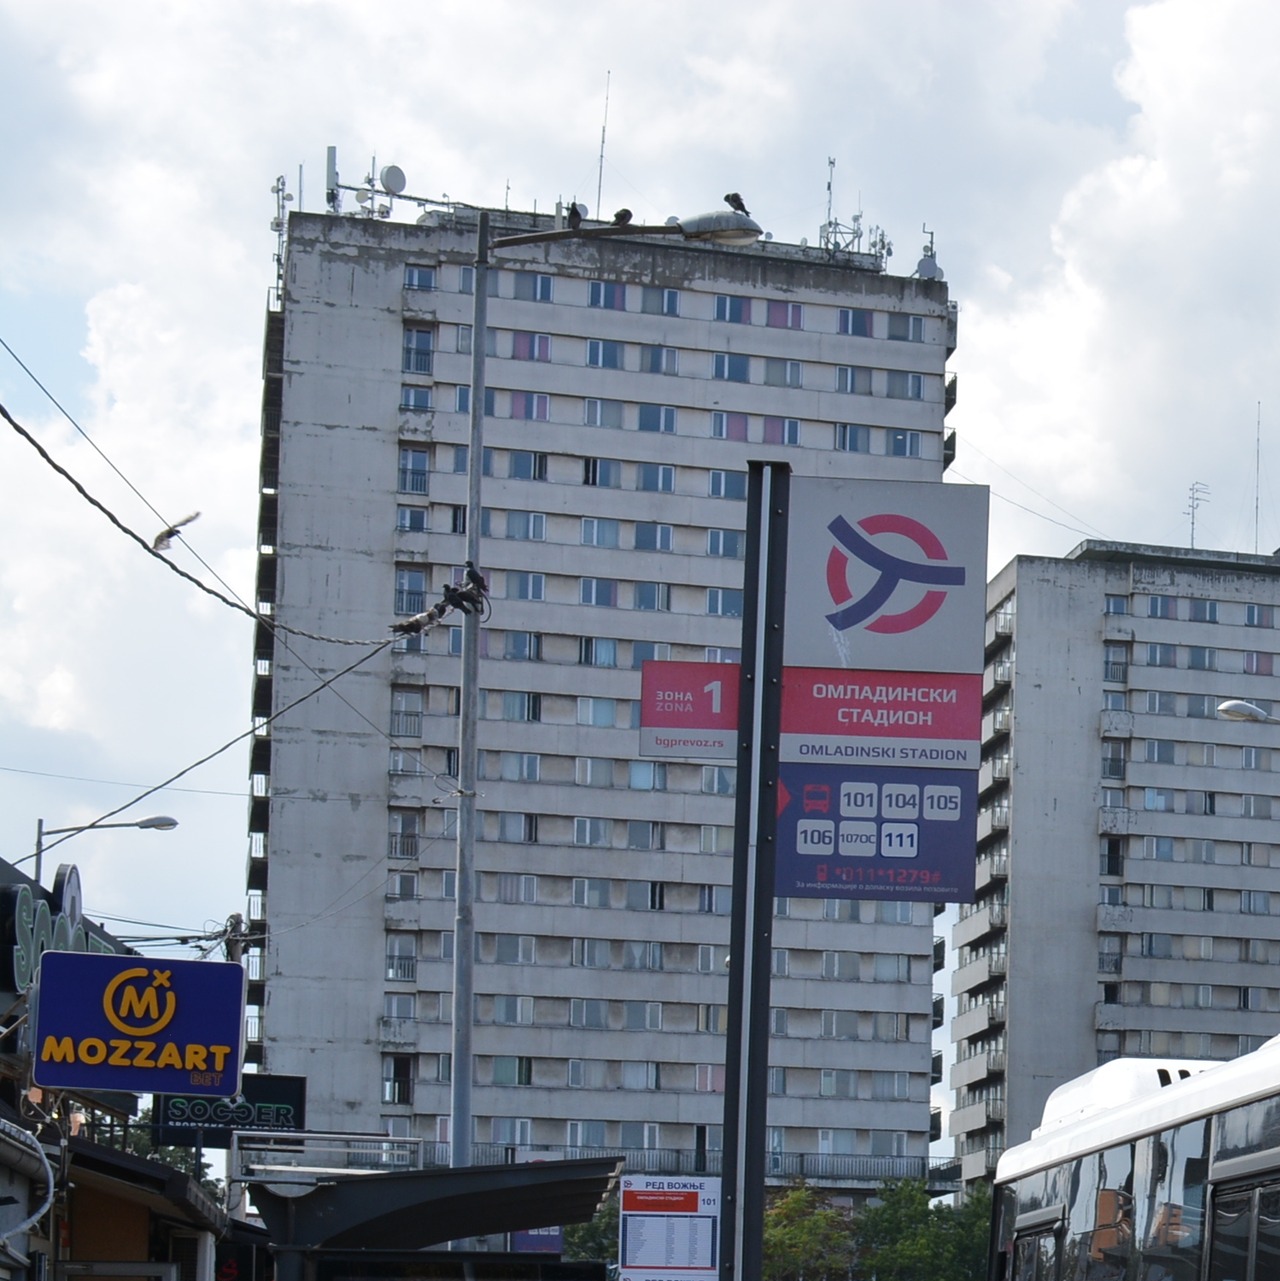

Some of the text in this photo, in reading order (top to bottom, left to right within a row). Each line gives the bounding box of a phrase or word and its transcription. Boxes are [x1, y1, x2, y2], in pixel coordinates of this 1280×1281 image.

[655, 690, 694, 702] ЗОНА
[703, 680, 722, 714] 1
[812, 683, 958, 704] ОМЛАДИНСКИ
[655, 702, 694, 713] ZONA
[837, 708, 933, 726] СТАДИОН
[654, 735, 725, 749] bgprevoz.rs
[799, 744, 968, 761] OMLADINSKI STADION
[843, 792, 960, 811] 101 104 105
[800, 829, 833, 846] 106
[885, 832, 916, 848] 111
[41, 1035, 231, 1072] MOZZART
[190, 1071, 223, 1087] BET
[645, 1181, 705, 1190] РЕД ВОЖЊЕ
[701, 1198, 717, 1206] 101
